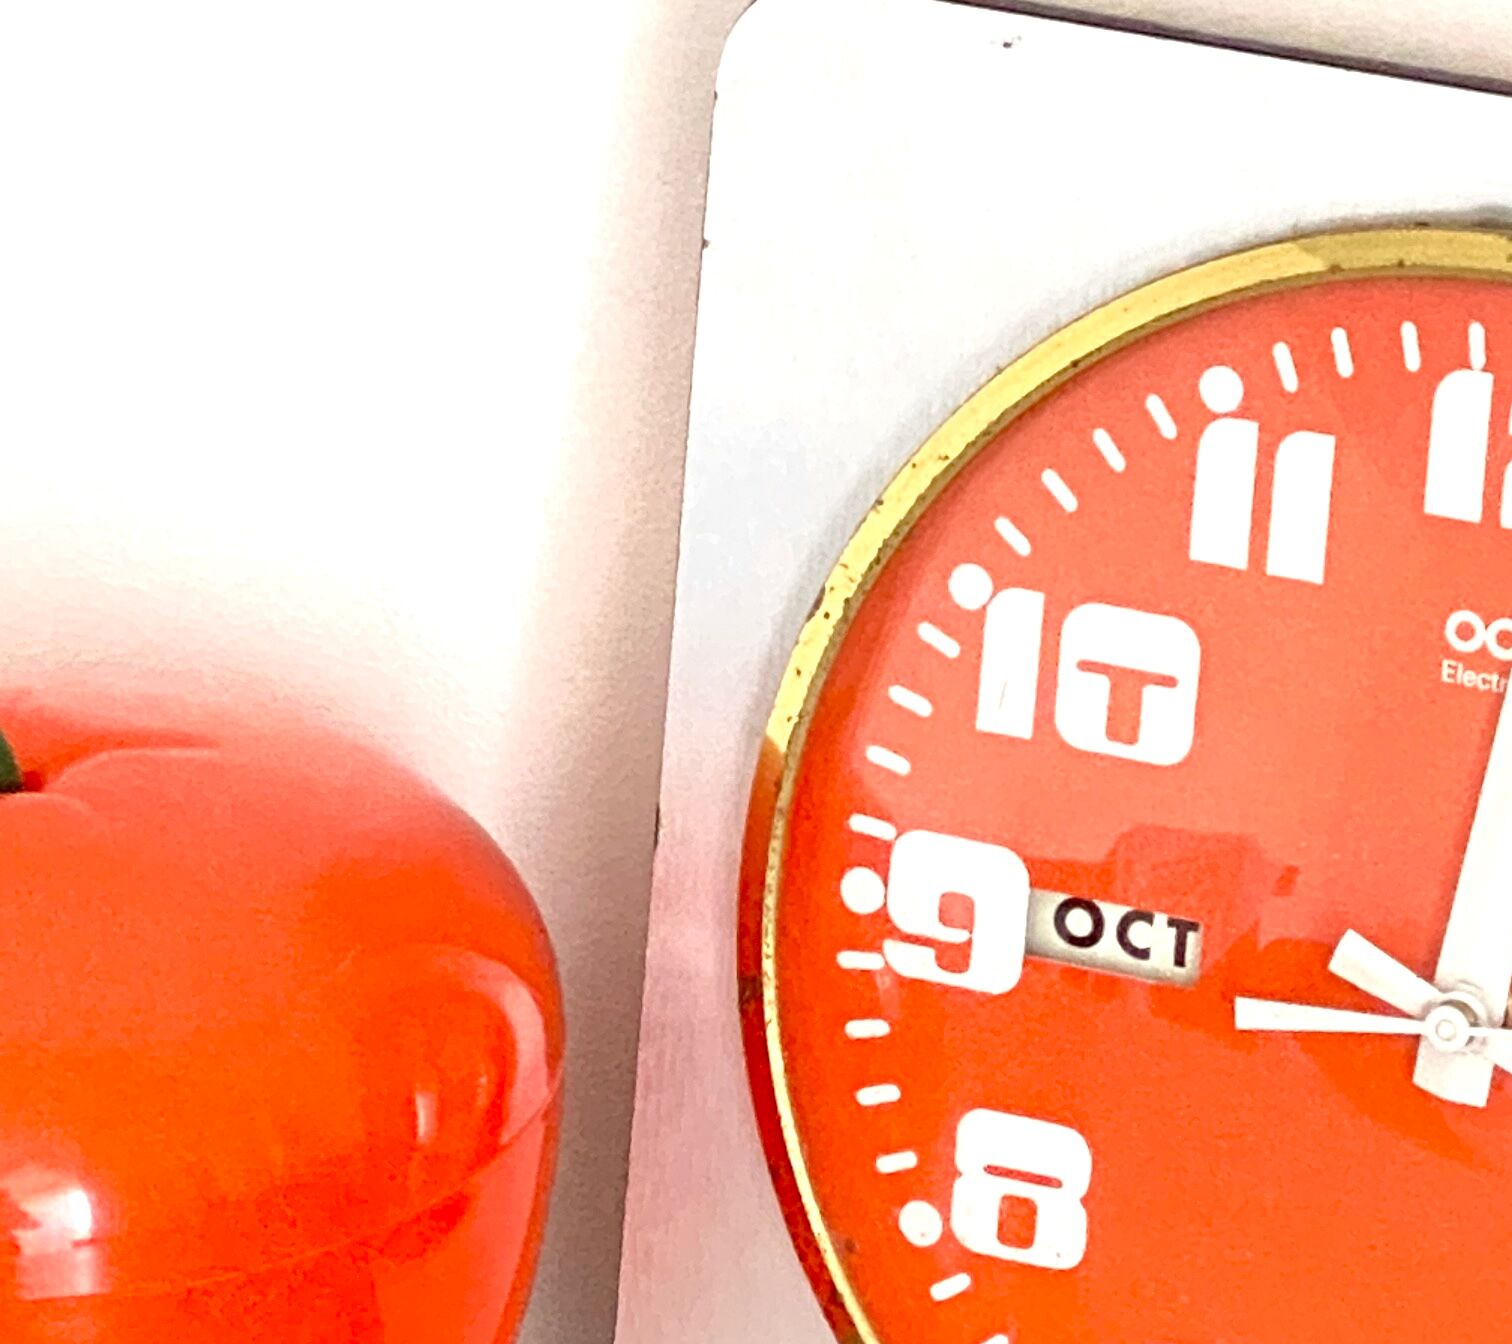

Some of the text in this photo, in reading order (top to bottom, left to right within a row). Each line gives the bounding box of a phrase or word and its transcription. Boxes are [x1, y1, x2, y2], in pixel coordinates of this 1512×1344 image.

[1188, 416, 1336, 584] 11
[975, 586, 1201, 767] 10
[883, 829, 1030, 994] 9
[1053, 896, 1200, 969] OCT
[951, 1108, 1092, 1270] 8
